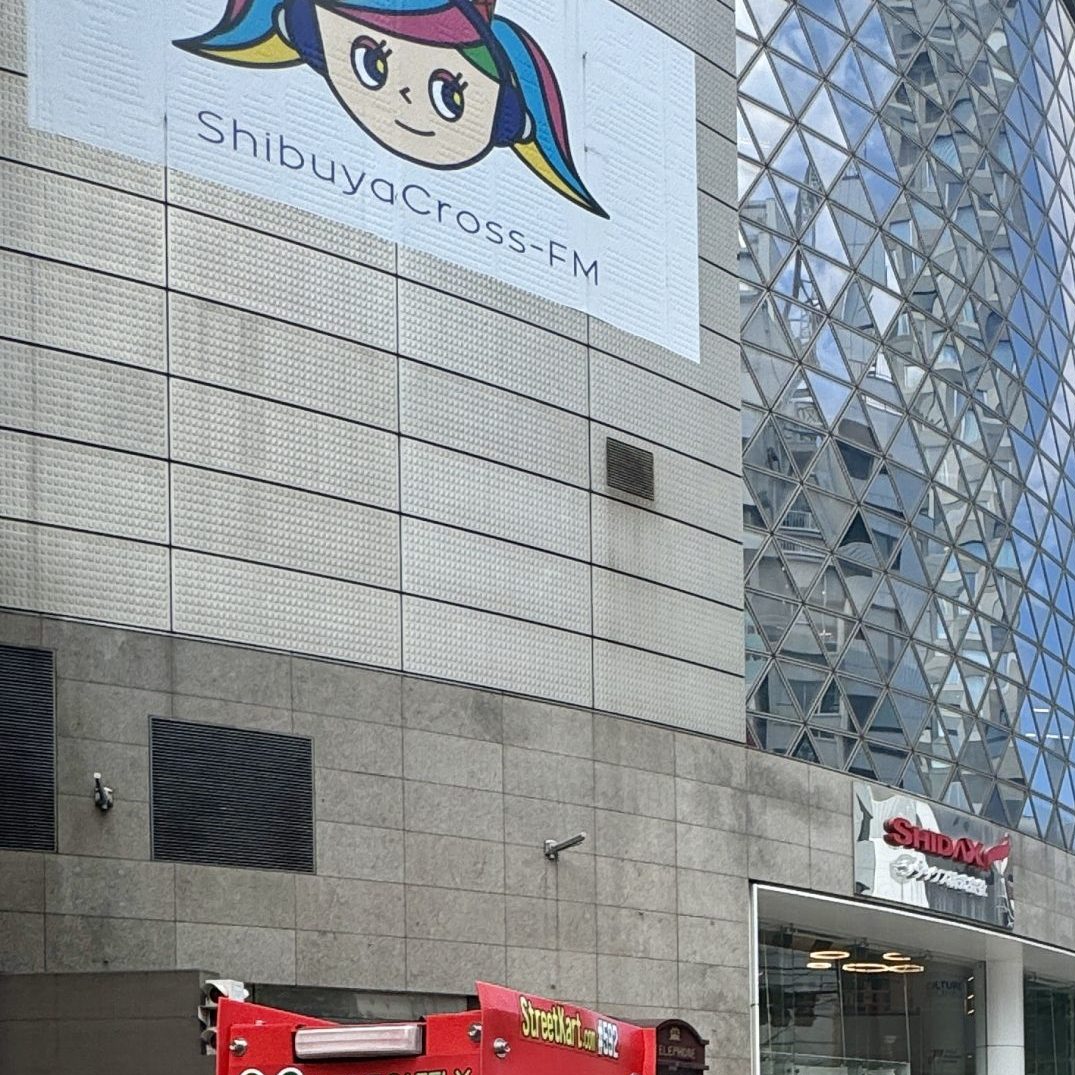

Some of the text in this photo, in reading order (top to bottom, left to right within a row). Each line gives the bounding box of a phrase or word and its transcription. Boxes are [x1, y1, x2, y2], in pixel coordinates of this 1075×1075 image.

[196, 110, 600, 287] ShibuyaCross-FM
[883, 816, 1010, 872] SHIDAX
[519, 995, 596, 1051] StreetKart.com
